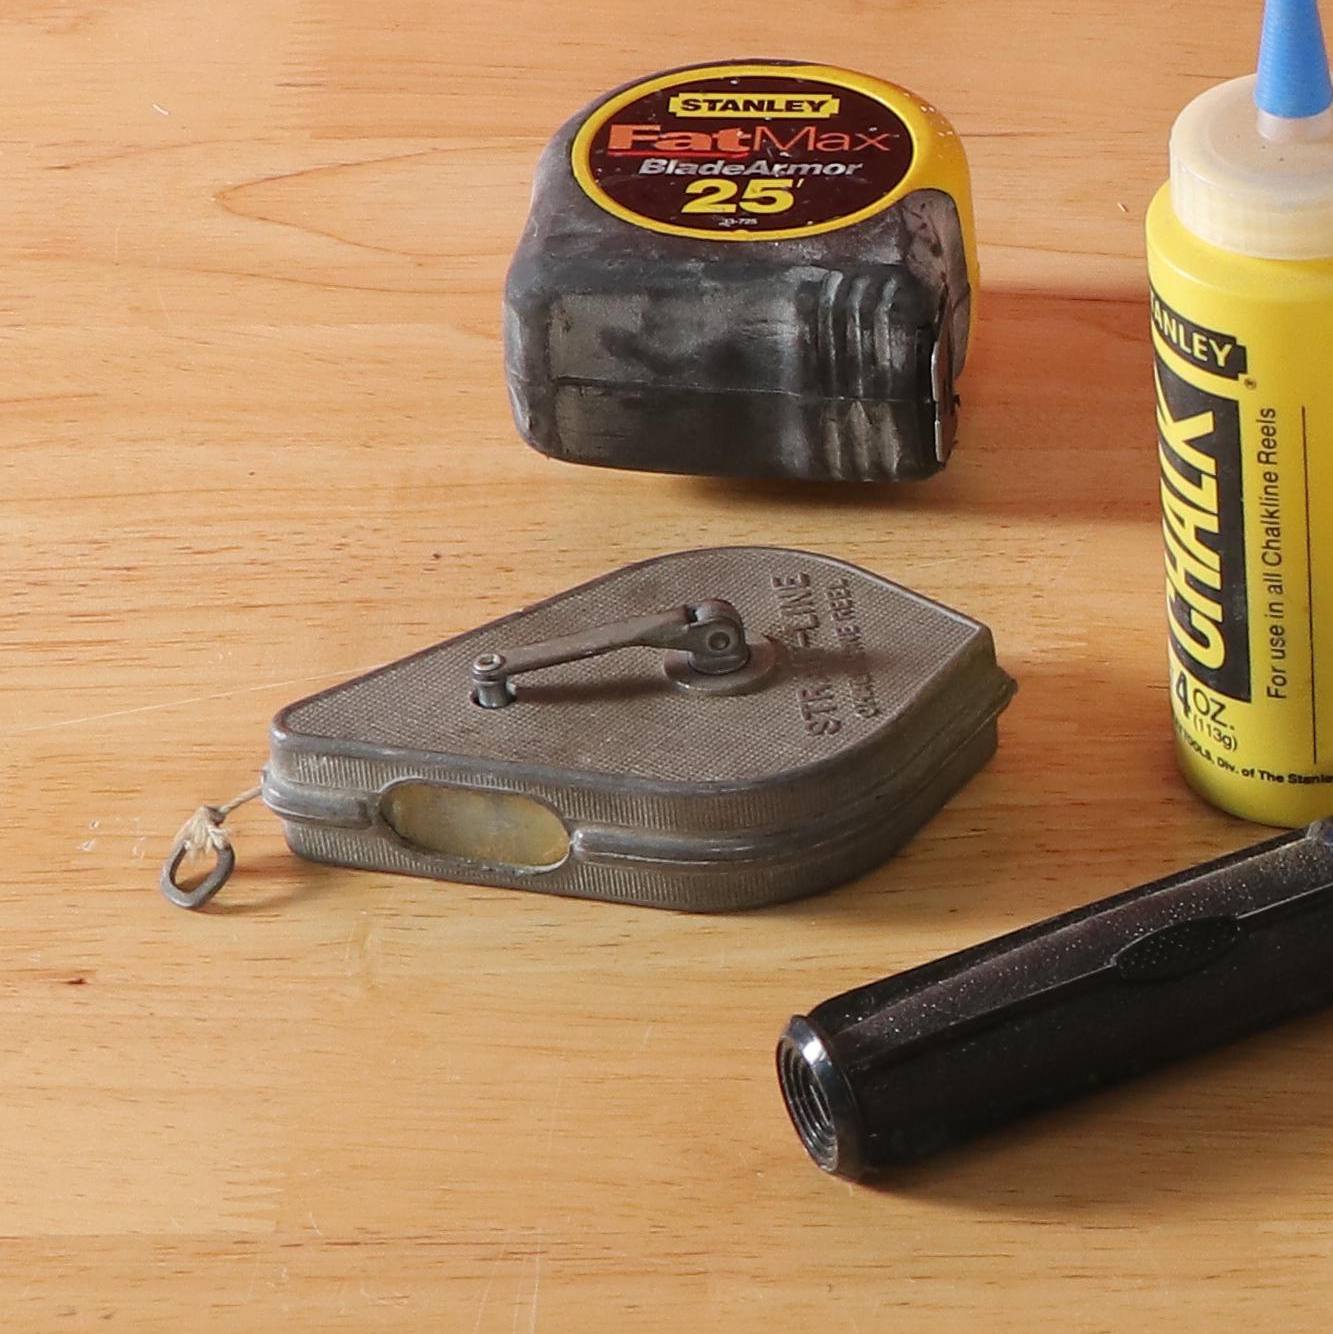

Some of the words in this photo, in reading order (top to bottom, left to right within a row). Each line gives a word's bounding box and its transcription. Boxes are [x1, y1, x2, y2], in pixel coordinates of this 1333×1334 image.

[680, 98, 829, 113] STANLEY
[607, 123, 891, 154] FatMax
[638, 157, 864, 177] BladeArmor
[680, 178, 804, 214] 25'
[1151, 289, 1233, 368] ANLEY
[1256, 407, 1277, 466] Reels
[1154, 361, 1226, 671] CHALK
[1260, 471, 1282, 567] Chalkline
[1262, 571, 1283, 595] all
[1264, 601, 1284, 619] in
[1268, 624, 1286, 661] use
[1176, 670, 1192, 720] 4
[1192, 687, 1236, 731] OZ.
[1266, 666, 1288, 699] For
[1193, 714, 1238, 753] (113g)
[1241, 768, 1256, 779] of
[1258, 769, 1285, 784] The
